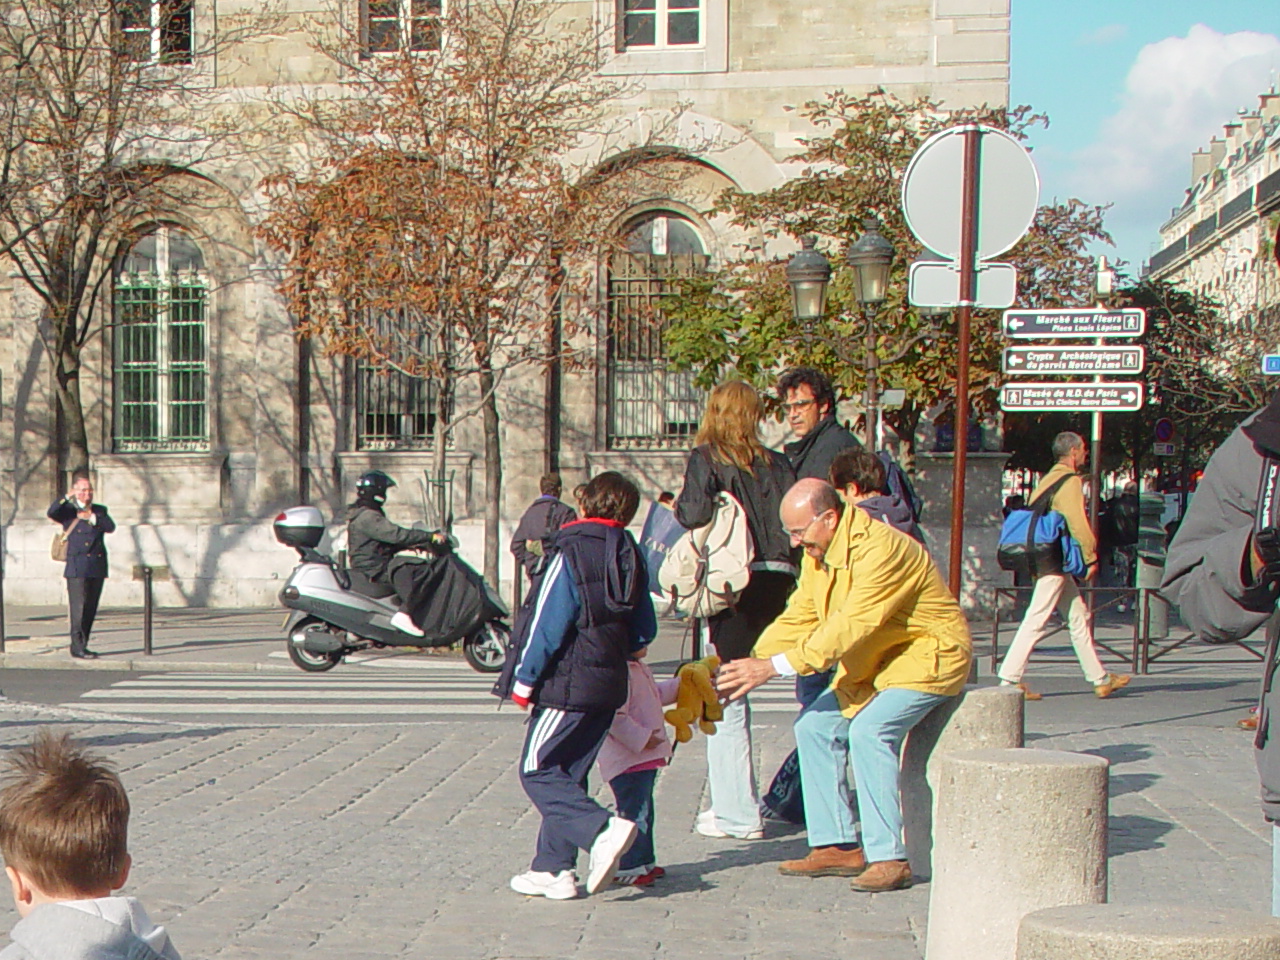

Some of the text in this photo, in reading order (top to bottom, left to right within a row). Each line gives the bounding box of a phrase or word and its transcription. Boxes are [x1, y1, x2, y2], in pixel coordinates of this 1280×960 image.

[1036, 315, 1121, 324] Marché aux Fleurs
[1027, 352, 1054, 361] Crypte
[1038, 361, 1067, 370] parvis
[1068, 361, 1093, 369] Notre
[1095, 361, 1121, 369] Dame
[1023, 389, 1052, 397] Musée
[1096, 389, 1118, 397] Paris
